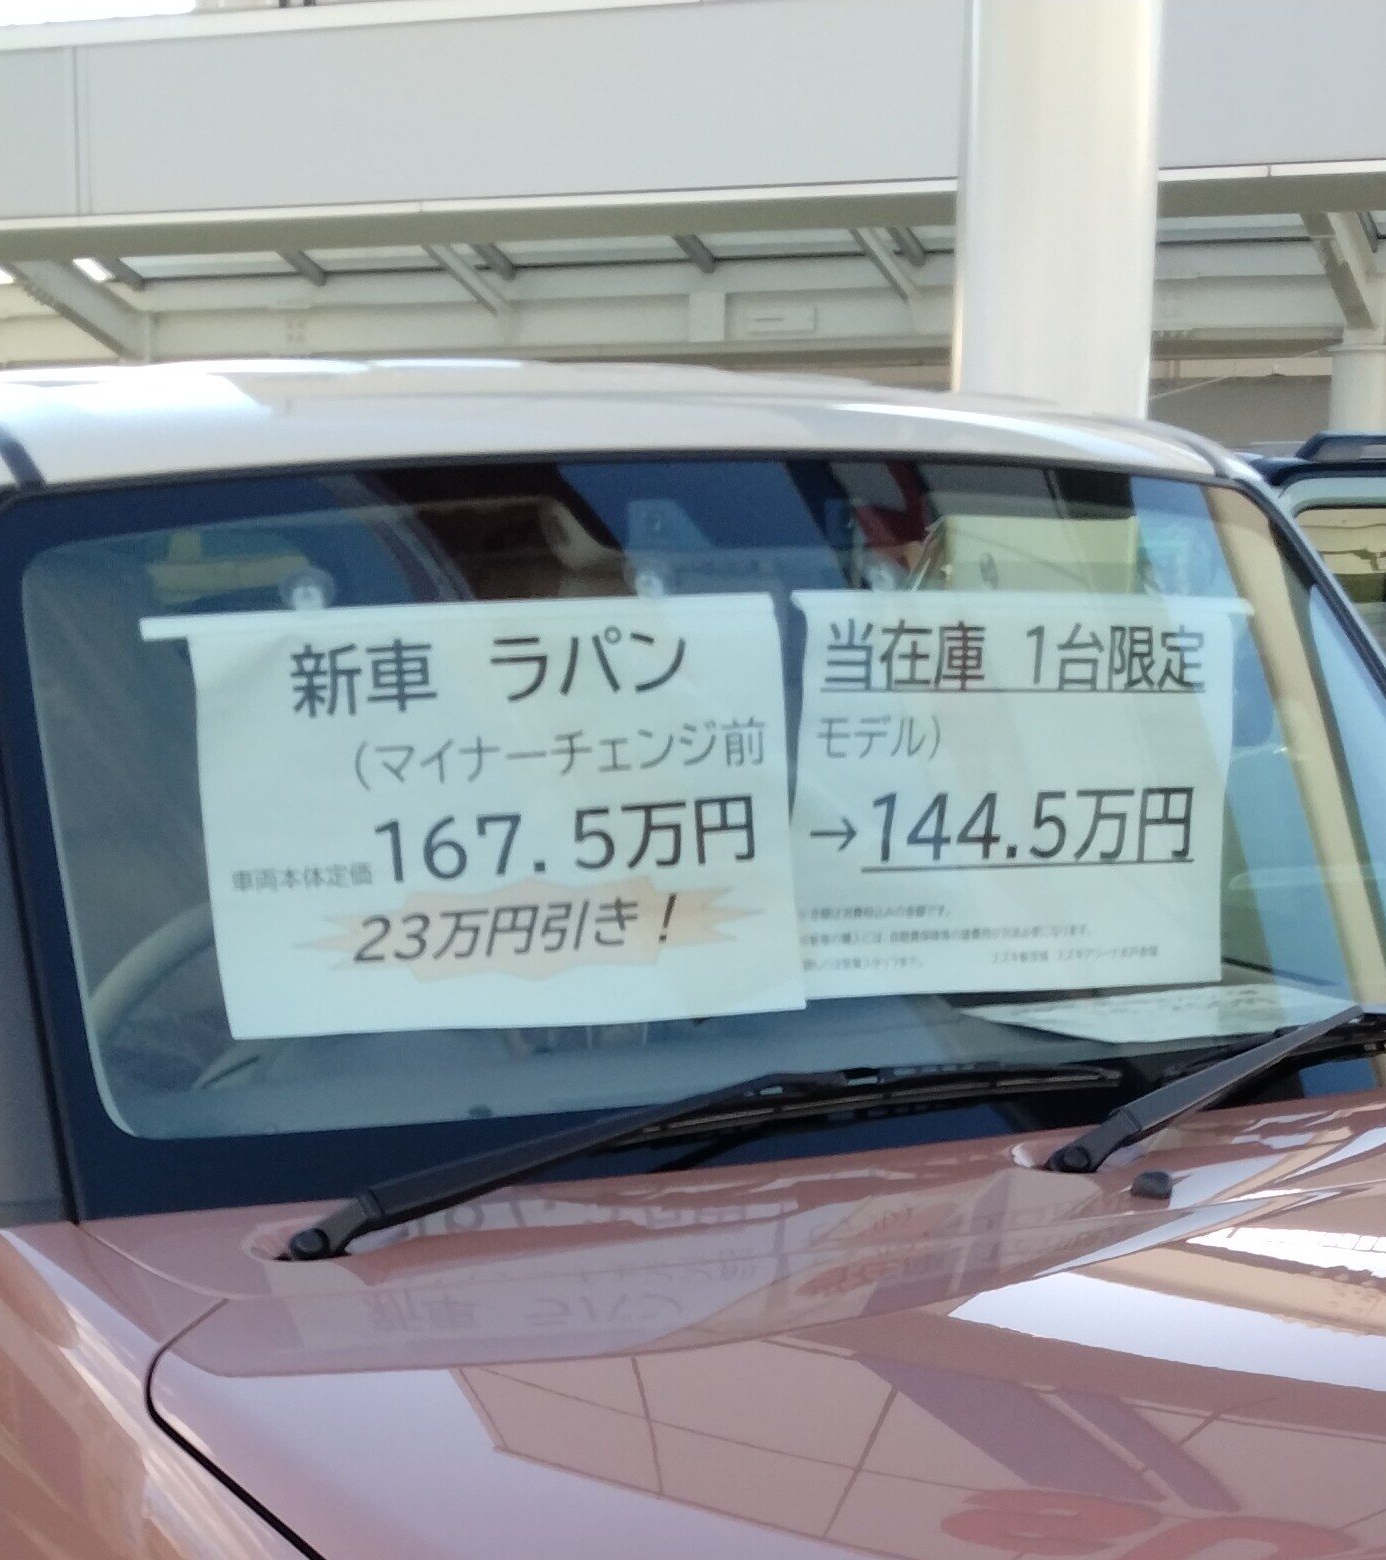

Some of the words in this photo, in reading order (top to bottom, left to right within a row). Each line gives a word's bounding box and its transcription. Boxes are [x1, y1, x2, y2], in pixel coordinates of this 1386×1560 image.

[290, 638, 438, 718] 新車
[490, 625, 686, 702] ラパン
[826, 618, 986, 691] 当在庫
[1025, 623, 1205, 691] 1台限定
[816, 714, 943, 761] モデル)
[374, 795, 757, 883] 167.5万円
[871, 786, 1195, 862] 144.5万円
[353, 894, 677, 963] 23万円引き!
